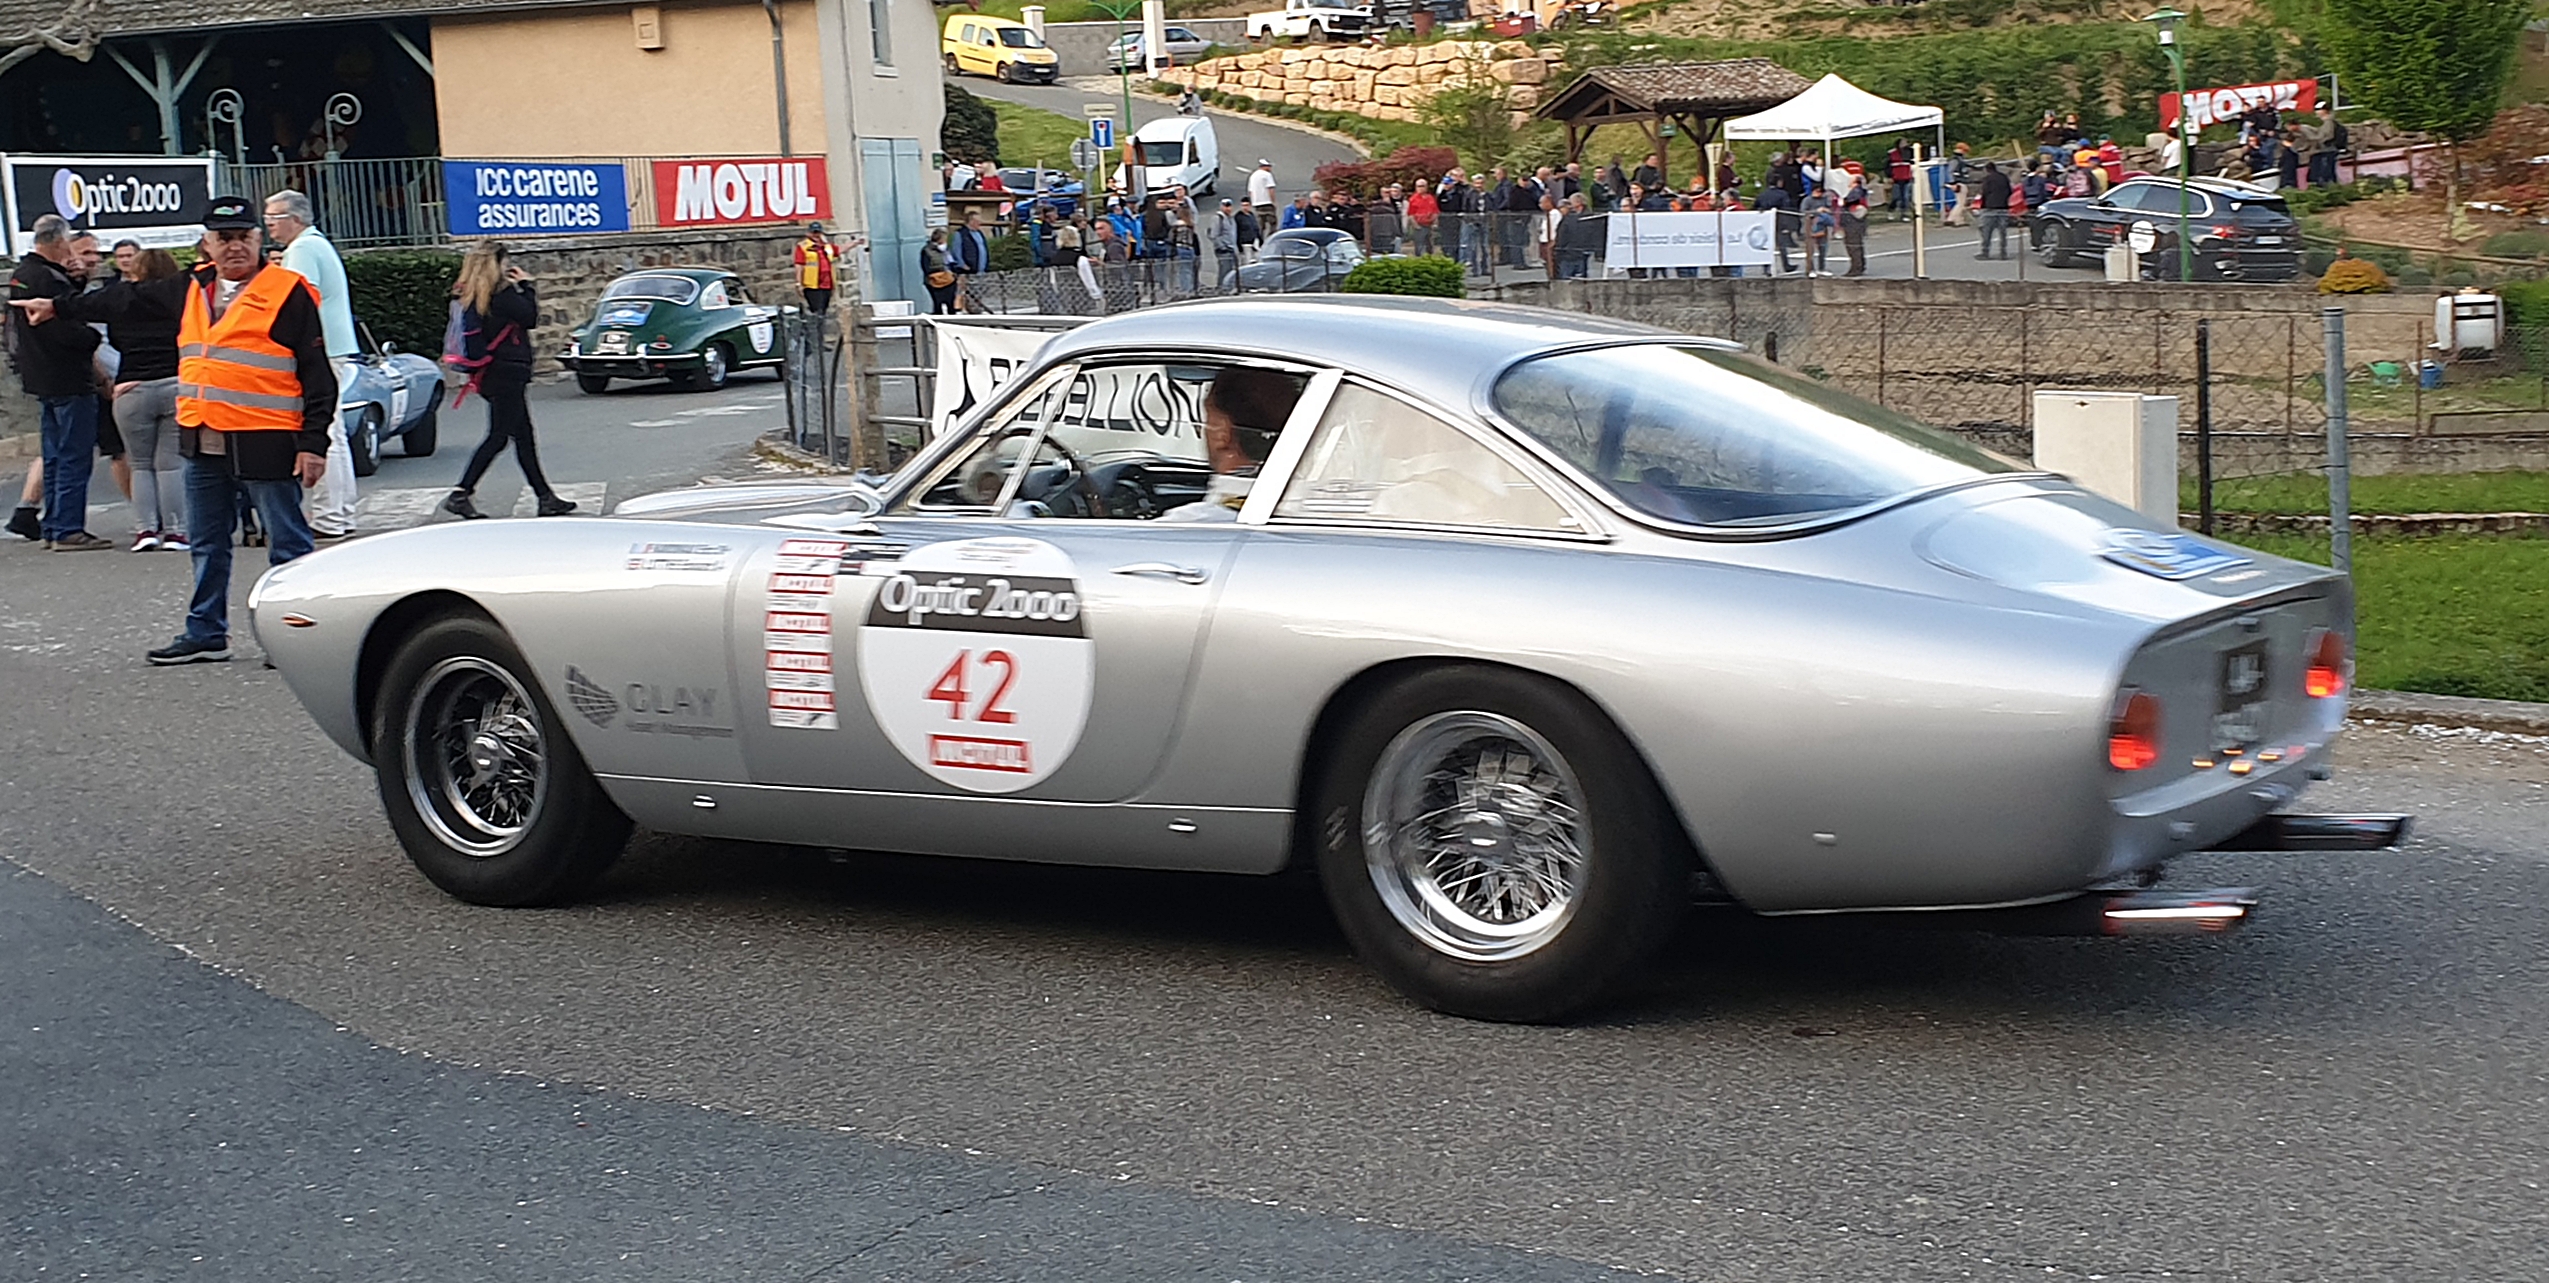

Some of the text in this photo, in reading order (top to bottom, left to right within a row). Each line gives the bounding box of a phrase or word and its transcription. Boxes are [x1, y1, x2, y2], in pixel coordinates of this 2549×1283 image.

[475, 168, 599, 197] ICC carene
[674, 163, 816, 221] MOTUL
[478, 203, 601, 228] assurances
[981, 578, 1082, 622] 2000
[923, 648, 1021, 724] 42
